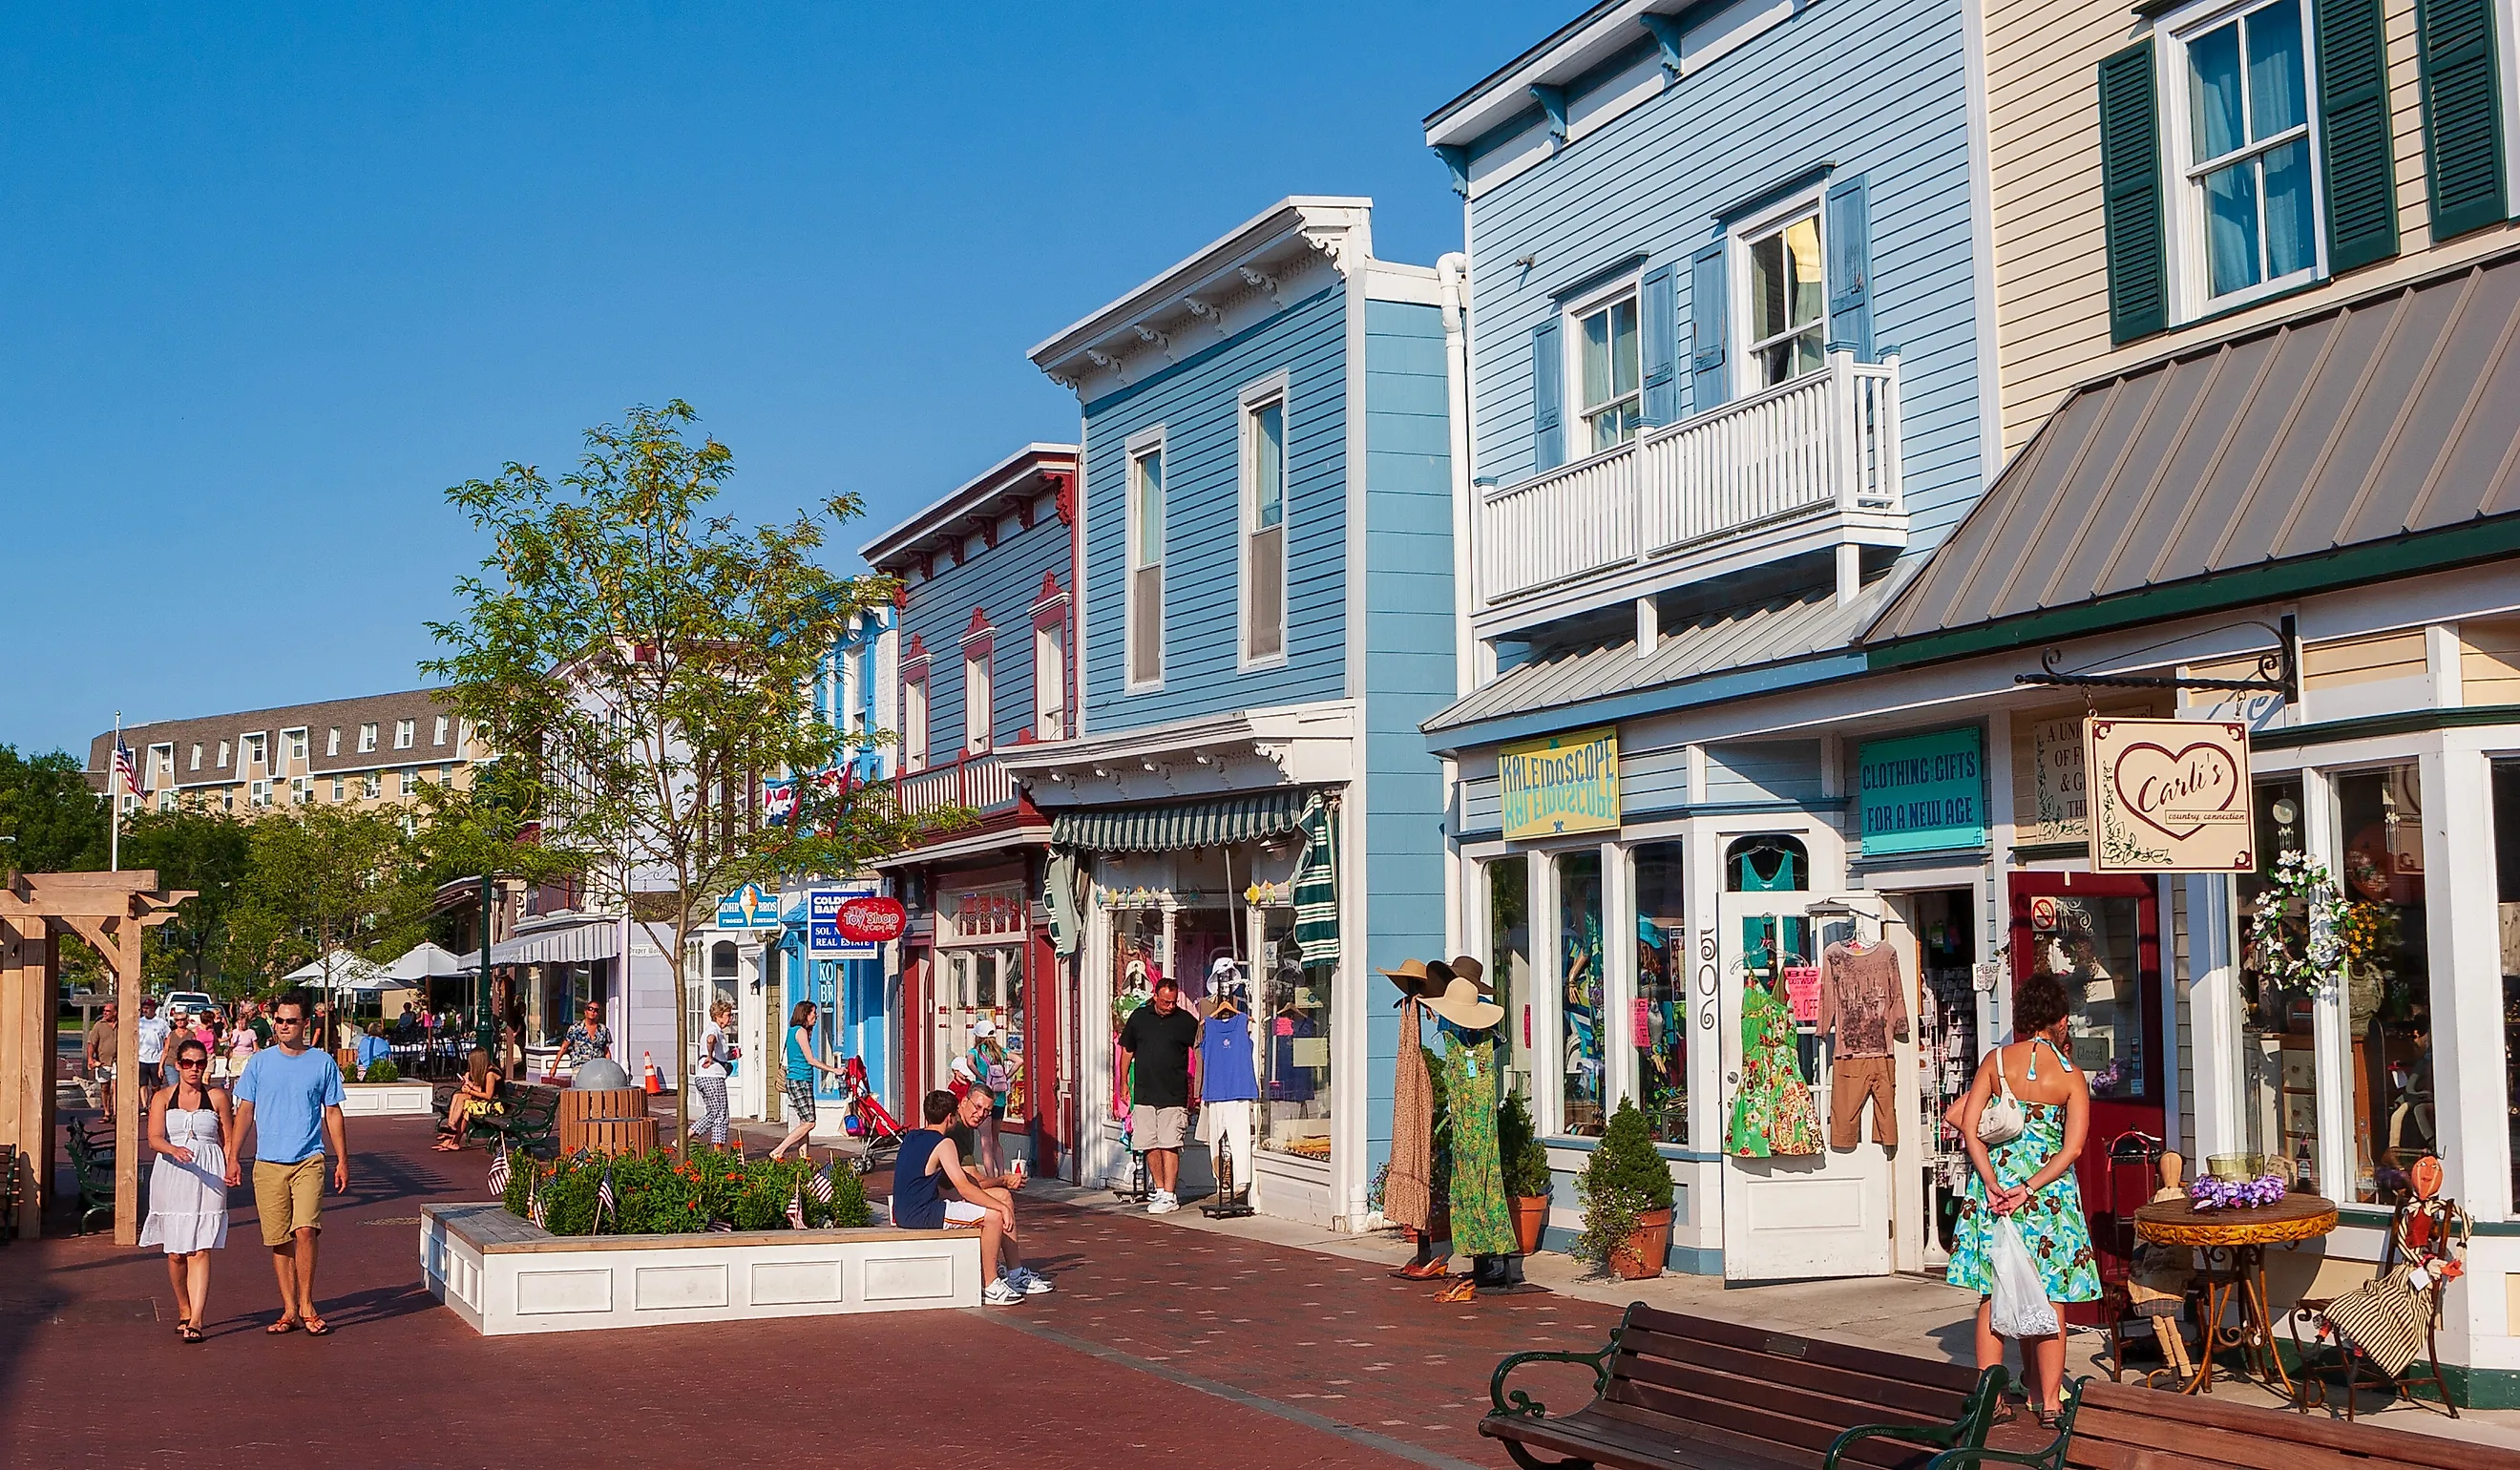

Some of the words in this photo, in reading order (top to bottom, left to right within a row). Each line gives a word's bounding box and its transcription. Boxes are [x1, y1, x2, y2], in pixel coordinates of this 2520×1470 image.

[2047, 725, 2055, 743] A
[2059, 722, 2084, 742] UNI
[1502, 734, 1614, 793] KALEIDOSCOPE
[2054, 748, 2069, 767] OF
[1862, 758, 1929, 790] CLOTHING
[1935, 750, 1977, 782] GIFTS
[2060, 773, 2070, 792] &
[2137, 752, 2224, 813] Carli's
[1867, 805, 1893, 832] FOR
[1897, 804, 1906, 830] A
[1909, 799, 1942, 829] NEW
[1945, 796, 1973, 825] AGE
[2168, 812, 2200, 823] country
[719, 901, 740, 913] KOHR
[758, 901, 777, 913] BROS
[813, 895, 869, 905] COLD
[844, 914, 865, 929] Toy
[867, 911, 899, 928] Shop
[814, 927, 831, 935] SOL
[815, 937, 838, 946] REAL
[1698, 927, 1717, 1030] 506
[2077, 1046, 2103, 1061] Closed
